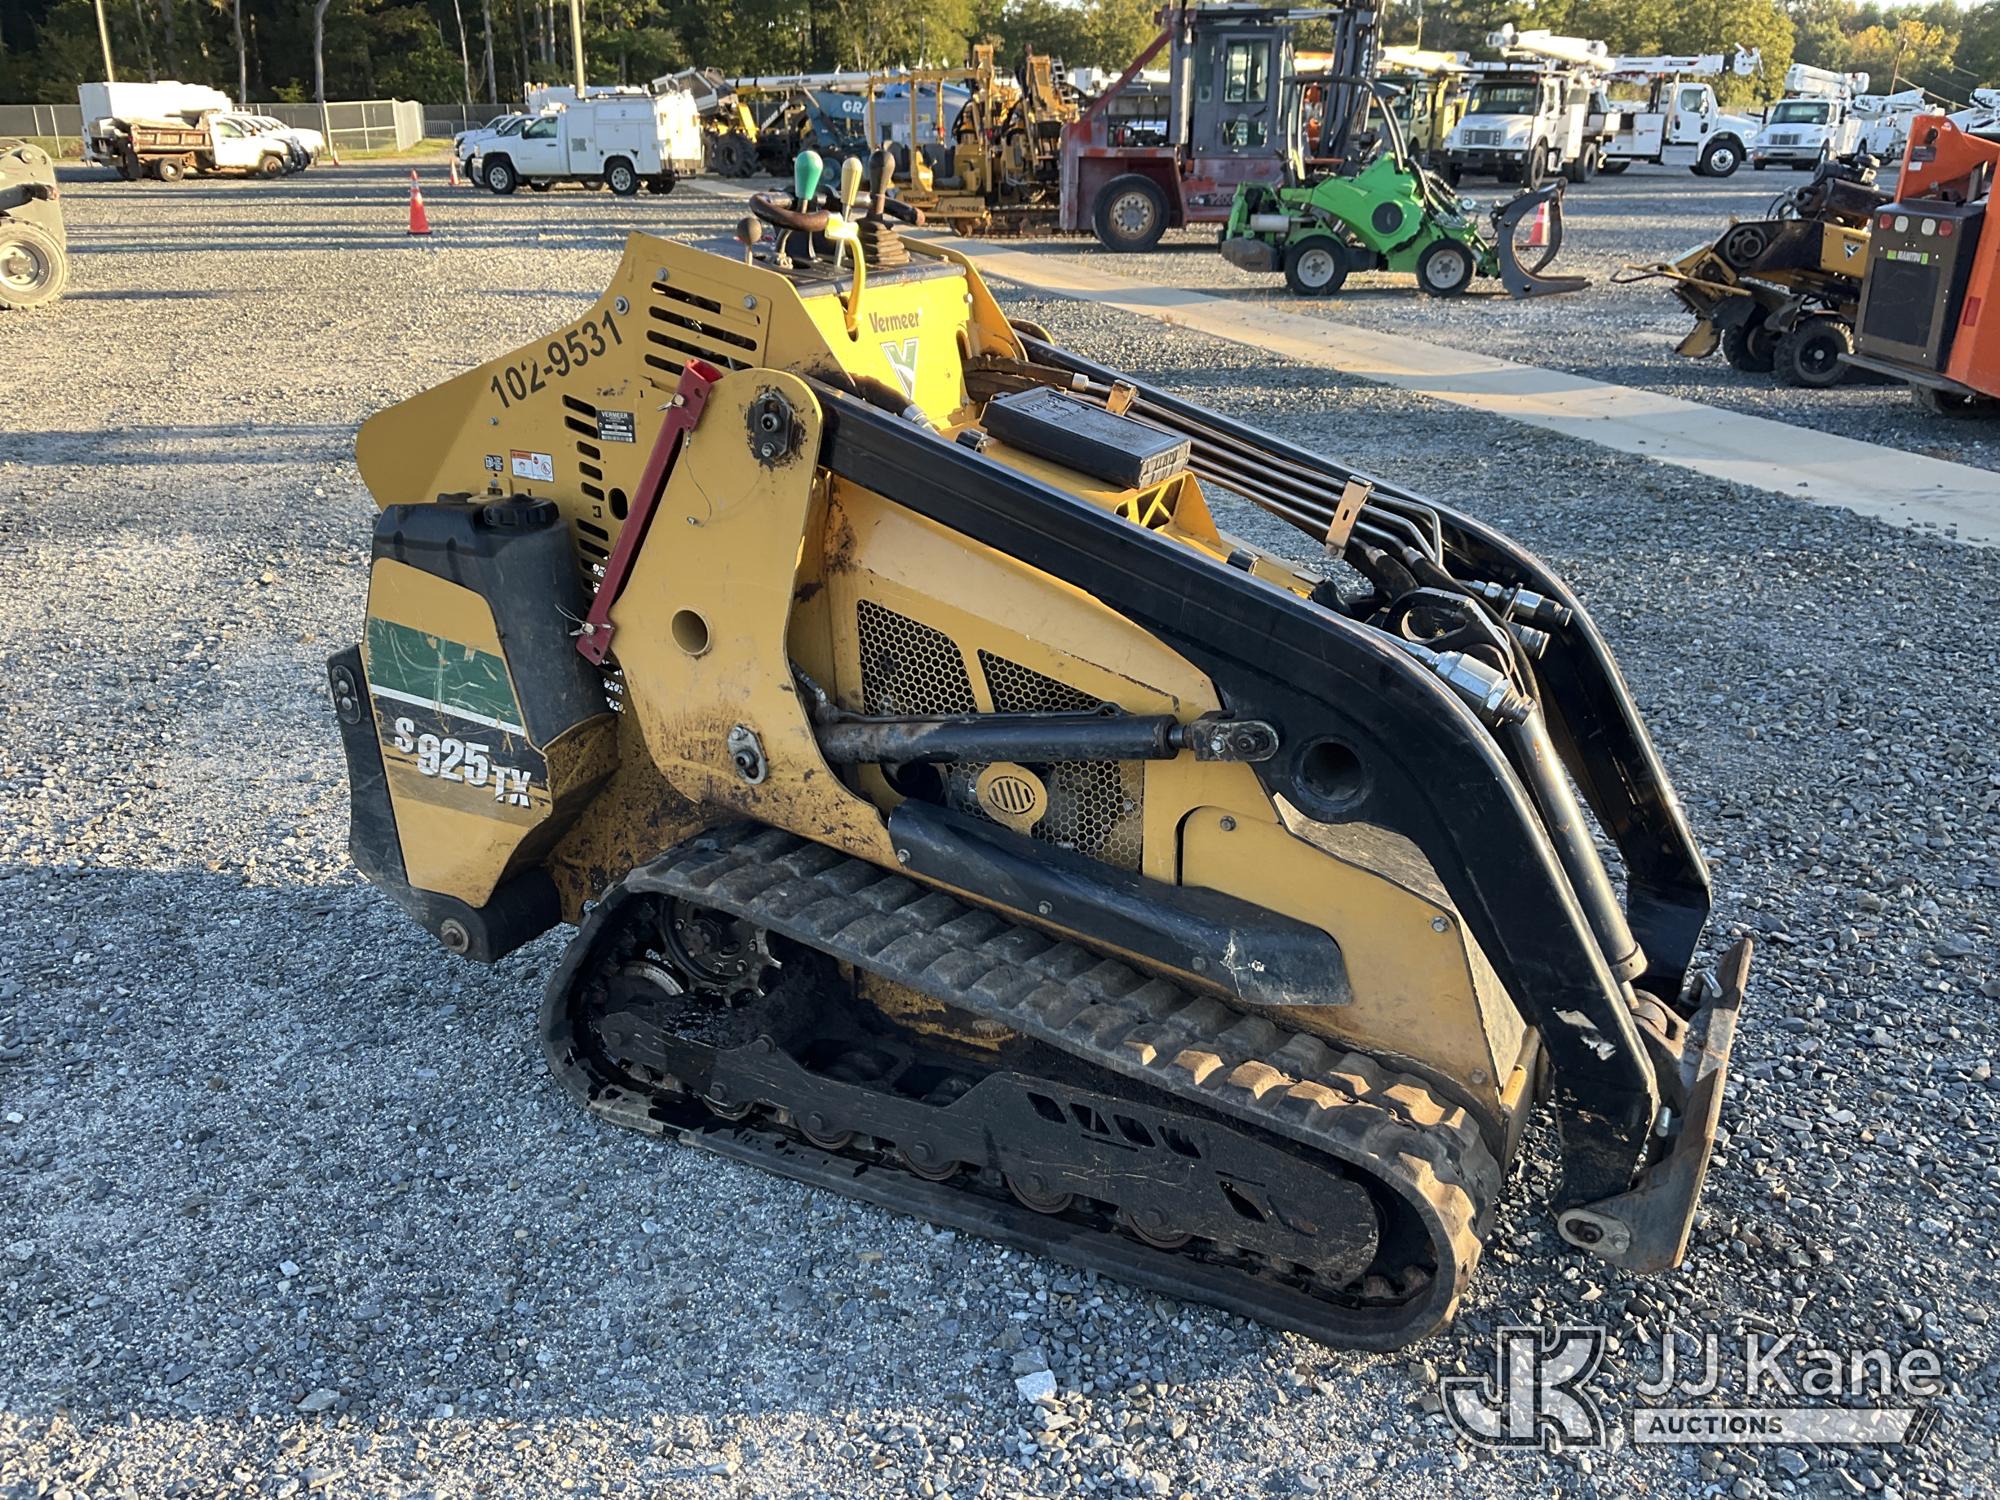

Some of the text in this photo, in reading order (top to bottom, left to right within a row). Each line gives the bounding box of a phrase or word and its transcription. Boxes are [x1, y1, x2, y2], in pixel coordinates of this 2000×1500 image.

[842, 100, 867, 113] GR
[868, 311, 919, 334] Vermeer
[491, 309, 623, 408] 102-9531
